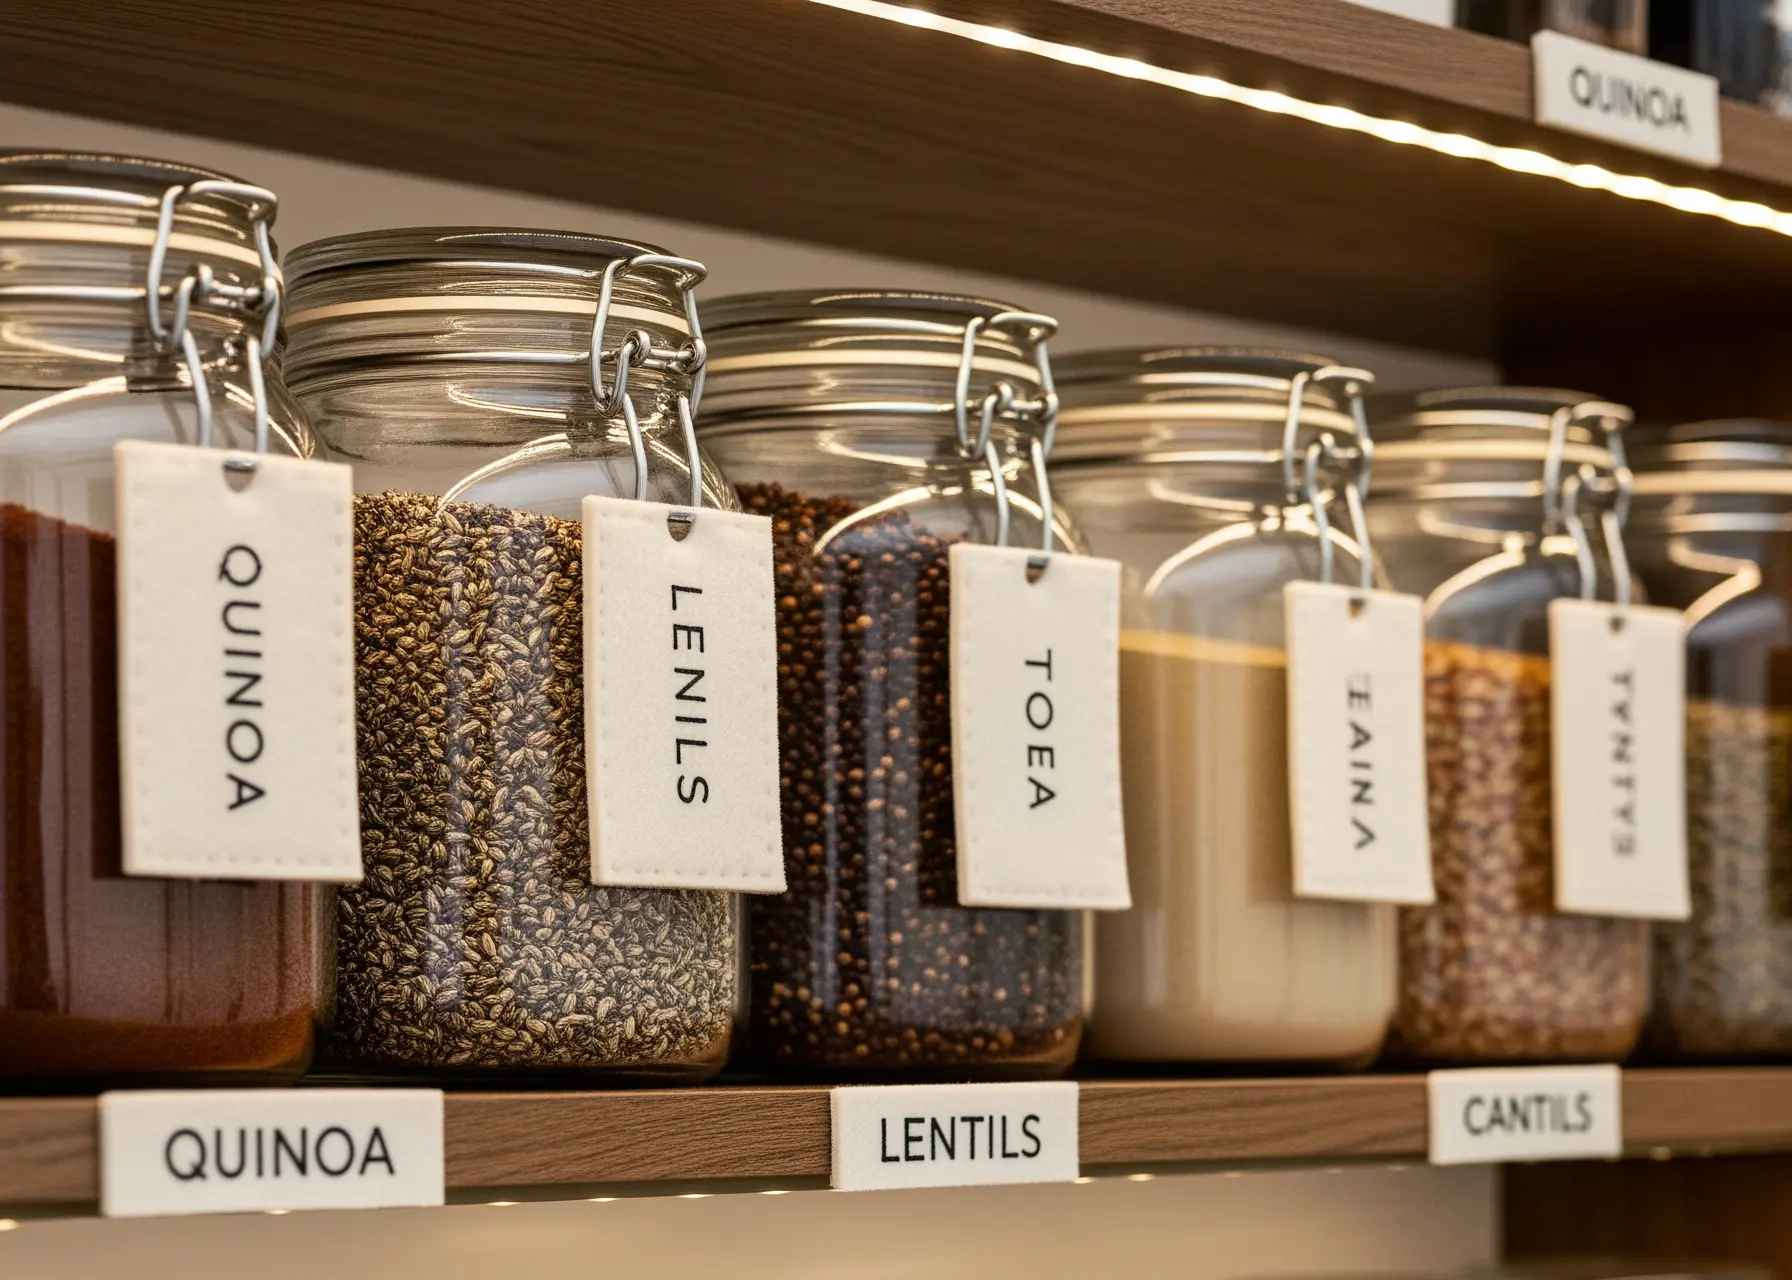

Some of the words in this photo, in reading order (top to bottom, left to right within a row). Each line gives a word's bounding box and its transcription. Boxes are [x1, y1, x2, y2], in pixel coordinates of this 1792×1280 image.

[1568, 65, 1692, 134] QUINOA
[218, 544, 266, 811] QUINOA
[671, 585, 709, 804] LENILS
[1025, 649, 1056, 809] TOEA
[881, 1114, 1041, 1163] LENTILS
[1463, 1092, 1592, 1137] CANTILS
[164, 1126, 395, 1182] QUINOA
